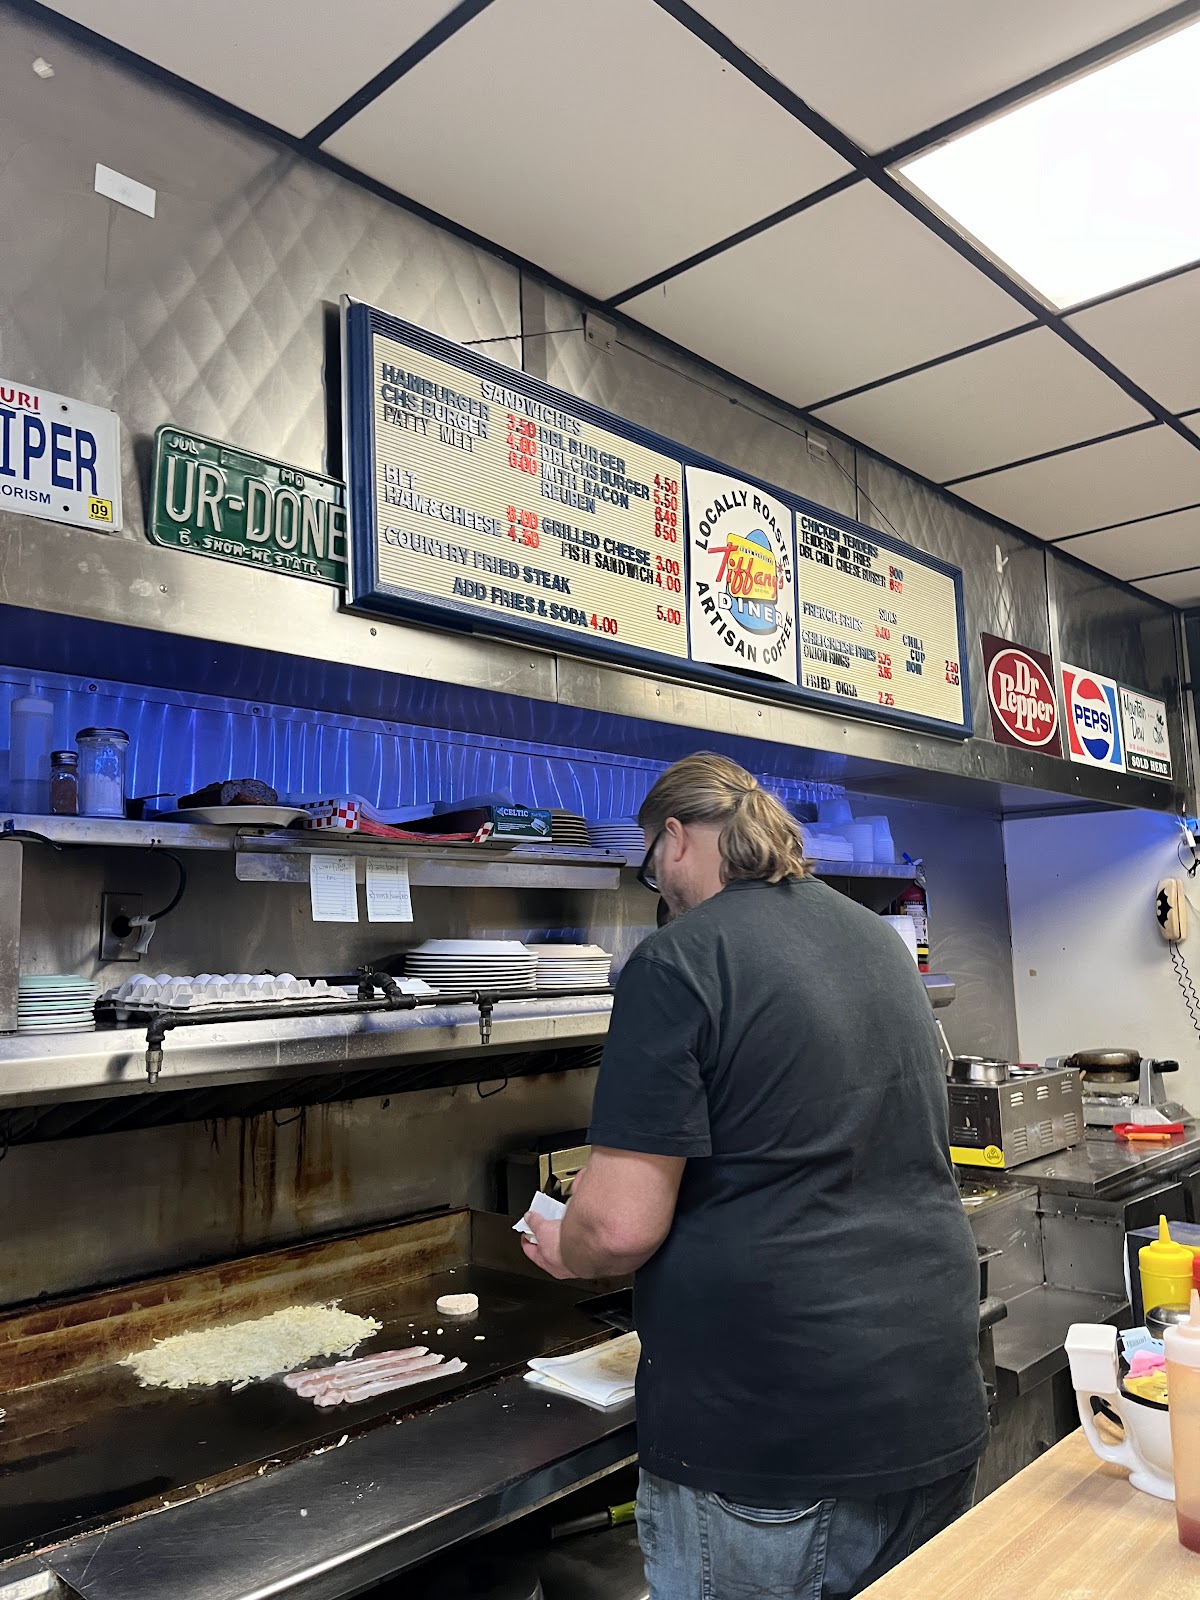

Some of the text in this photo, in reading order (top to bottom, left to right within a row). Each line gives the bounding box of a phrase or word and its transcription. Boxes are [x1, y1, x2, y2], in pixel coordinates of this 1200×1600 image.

[0, 386, 40, 411] URI
[382, 362, 537, 439] HAMBURGER 3.50
[480, 380, 582, 437] SANDWICHES
[381, 383, 538, 458] CHS BURGER 4.00
[384, 403, 429, 437] PATTY
[439, 424, 476, 452] MELT
[0, 408, 98, 496] IPER
[168, 436, 199, 455] JUL
[540, 425, 678, 496] DBL BURGER 4.50
[1, 484, 51, 504] ORISM
[541, 443, 678, 511] DBL CHS BURGER 5.50
[541, 462, 577, 491] WITH
[583, 478, 629, 510] BACON
[91, 503, 108, 517] 09
[165, 455, 346, 562] UR-DONE
[384, 484, 540, 549] HAM&CHEESE 4.50
[541, 481, 596, 514] REUBEN
[202, 535, 272, 566] SHOW-ME
[541, 516, 680, 577] GRILLED CHEESE 3.00
[695, 490, 792, 584] LOCALLY ROASTED
[800, 529, 835, 555] TENDERS
[836, 543, 851, 561] AND
[852, 549, 872, 569] FRIES
[801, 516, 879, 559] CHICKEN TENDERS
[384, 525, 682, 627] COUNTRY FRIED STEAK 5.00
[561, 541, 591, 565] FISH
[594, 551, 653, 585] SANDWICH
[815, 549, 834, 568] CHILI
[836, 558, 861, 580] CHEESE
[453, 576, 618, 636] ADD FRIES & SODA 4.00
[695, 581, 793, 665] ARTISAN COFFEE
[718, 592, 784, 629] DINER
[802, 601, 836, 625] FRENCH
[837, 611, 863, 632] FRIES
[878, 607, 898, 625] SIDES
[803, 643, 829, 664] ONION
[829, 652, 851, 669] RINGS
[824, 635, 855, 657] CHEESE
[855, 644, 877, 662] FRIES
[902, 633, 924, 652] CHILI
[910, 649, 926, 664] CUP
[805, 673, 831, 692] FRIED
[835, 680, 858, 698] OKRA
[1013, 659, 1040, 699] Dr
[997, 671, 1054, 733] Pepper
[1074, 703, 1112, 735] PEPSI
[1131, 756, 1168, 775] SOLD HERE
[503, 808, 529, 817] CELTIC
